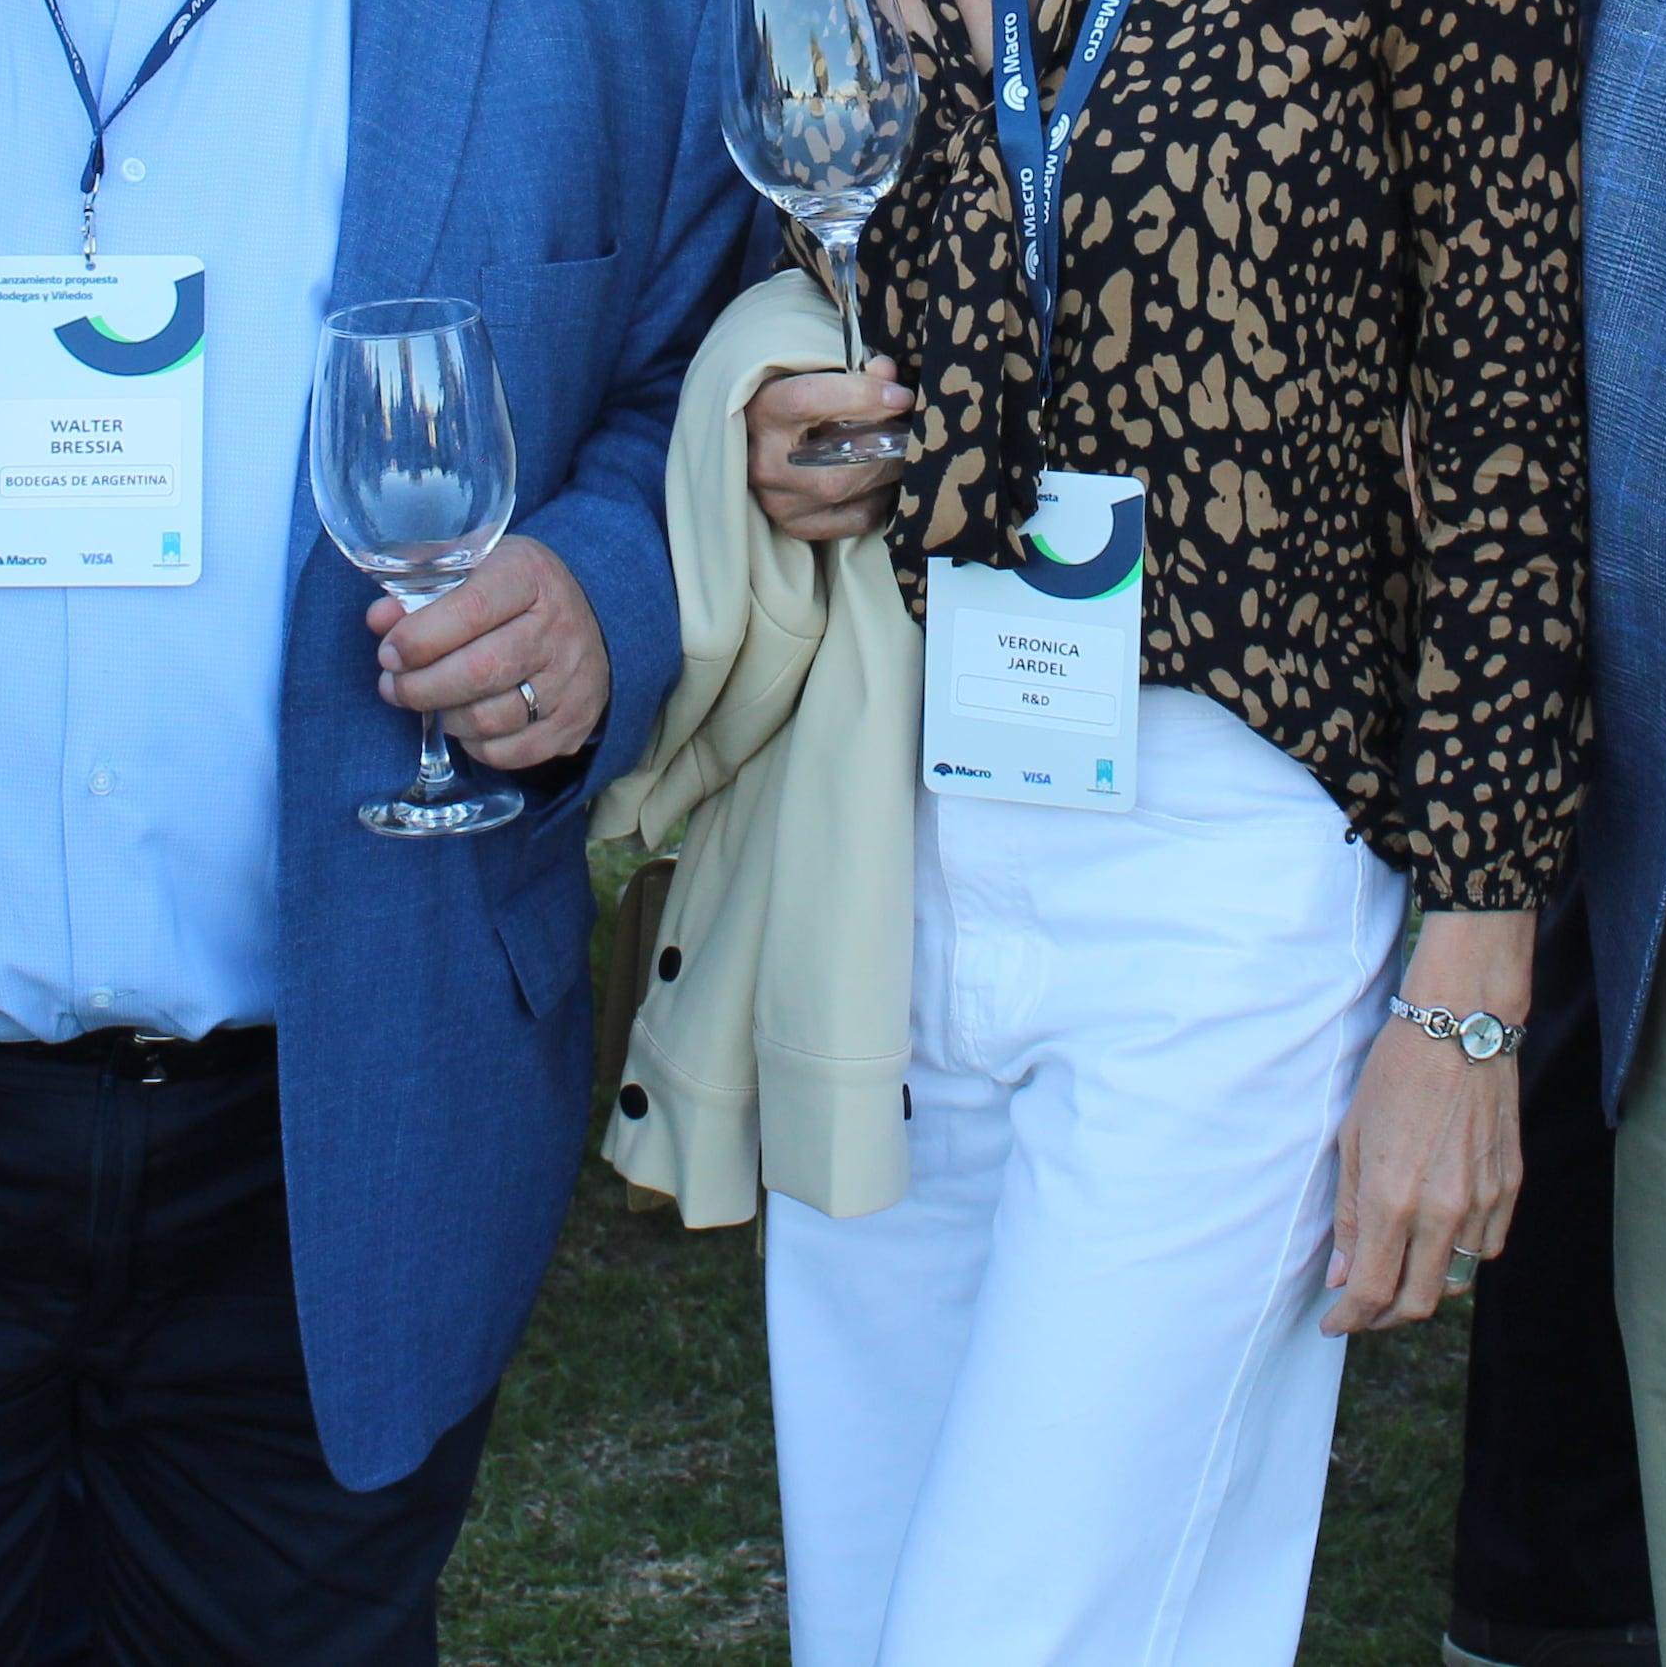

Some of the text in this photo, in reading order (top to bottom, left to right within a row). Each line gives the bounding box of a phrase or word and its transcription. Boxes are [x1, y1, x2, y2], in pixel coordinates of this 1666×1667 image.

[1002, 12, 1018, 75] Macro
[1020, 167, 1037, 237] Macro
[65, 276, 118, 289] propuesta
[42, 293, 49, 302] y
[51, 290, 93, 301] Viñedos
[51, 419, 123, 433] WALTER
[51, 441, 124, 454] BRESSIA
[5, 474, 167, 487] BODEGAS DE ARGENTINA
[6, 555, 47, 566] Macro
[79, 552, 114, 565] VISA
[998, 634, 1080, 657] VERONICA
[1007, 657, 1067, 677] JARDEL
[1022, 692, 1050, 707] R&D
[955, 765, 992, 779] Macro
[1022, 770, 1052, 785] VISA
